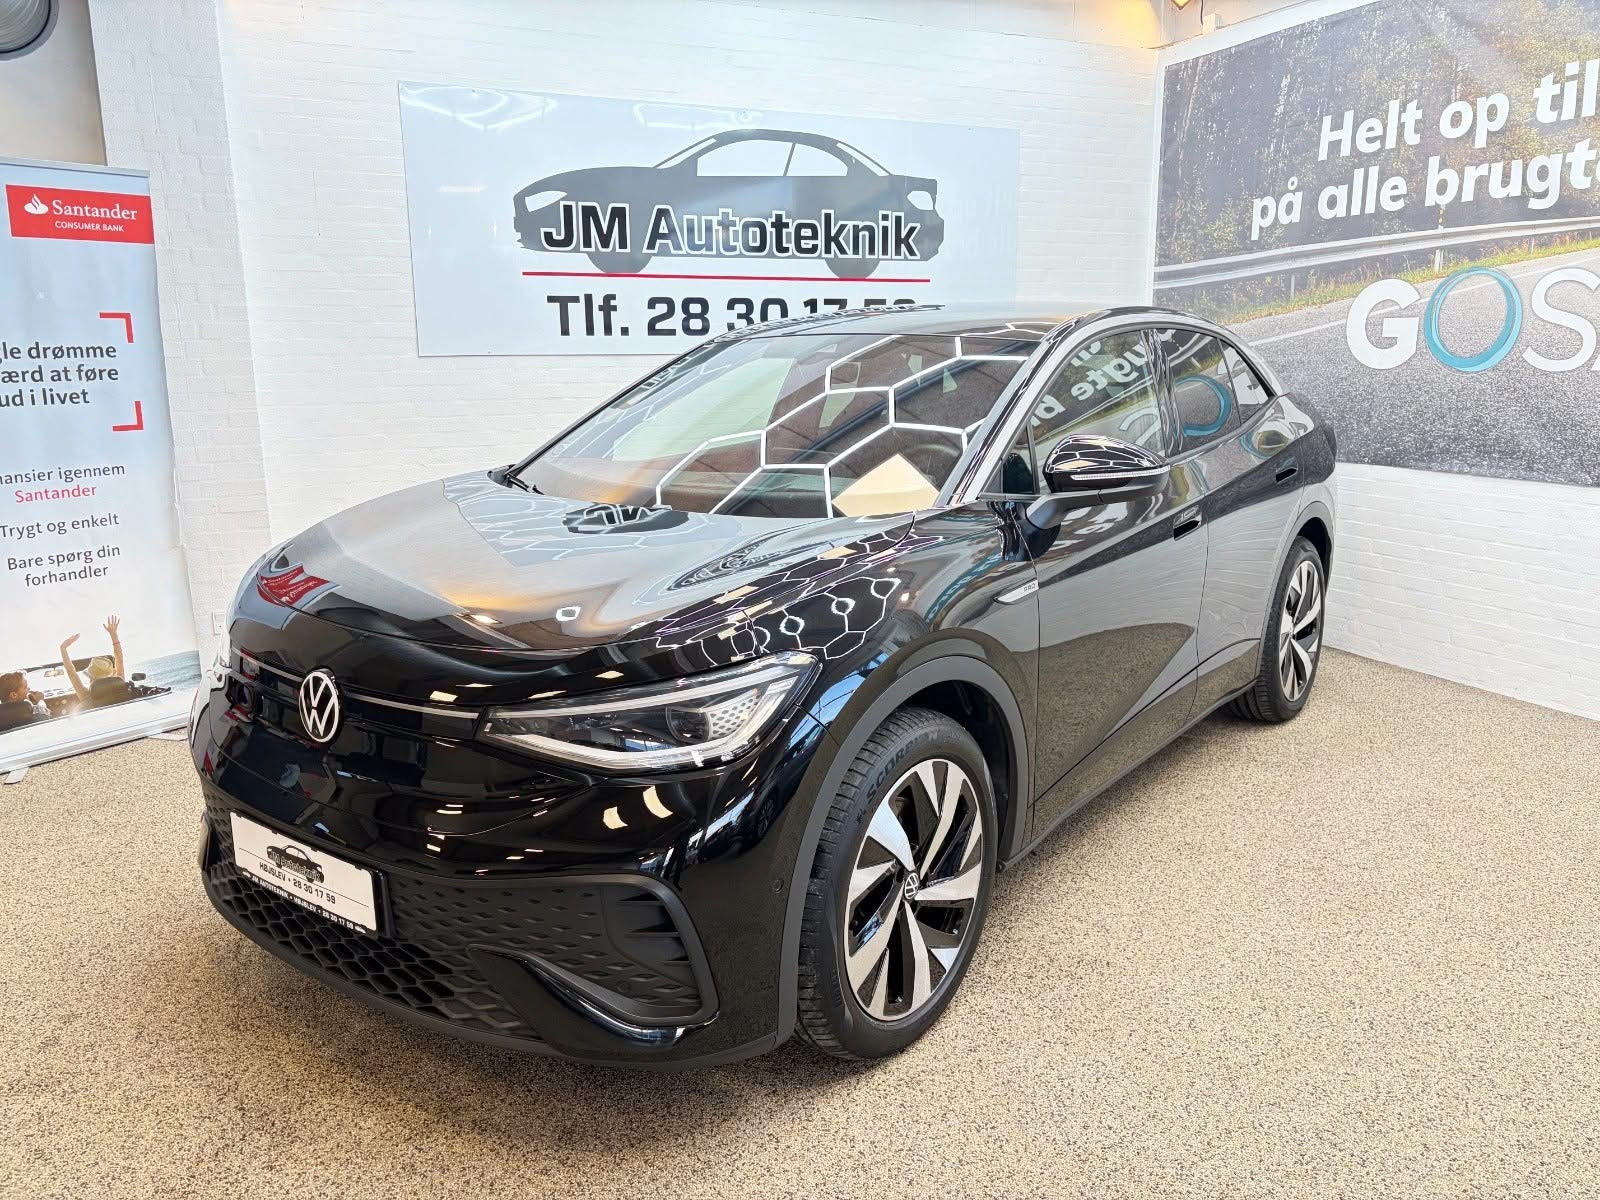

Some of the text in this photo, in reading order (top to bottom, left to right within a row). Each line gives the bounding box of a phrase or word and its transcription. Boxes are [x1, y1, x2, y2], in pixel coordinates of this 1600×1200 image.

[1317, 58, 1600, 161] Helt op til
[1251, 138, 1600, 240] på alle brugt
[52, 199, 138, 221] Santander
[54, 220, 125, 233] CONSUMER BANK
[540, 201, 921, 260] JM Autoteknik
[547, 293, 629, 337] Tlf.
[647, 297, 710, 337] 28
[1346, 266, 1600, 373] GOS
[0, 341, 117, 364] le drømme
[50, 366, 72, 382] at
[75, 364, 119, 382] føre
[30, 389, 36, 406] i
[42, 387, 90, 406] livet
[58, 464, 126, 484] igennem
[14, 484, 97, 503] Santander
[0, 512, 120, 541] Trygt og enkelt
[7, 544, 121, 571] Bare spørg din
[25, 564, 109, 587] forhandler
[293, 878, 302, 890] 28
[303, 883, 313, 895] 30
[314, 888, 323, 899] 17
[326, 892, 336, 904] 59
